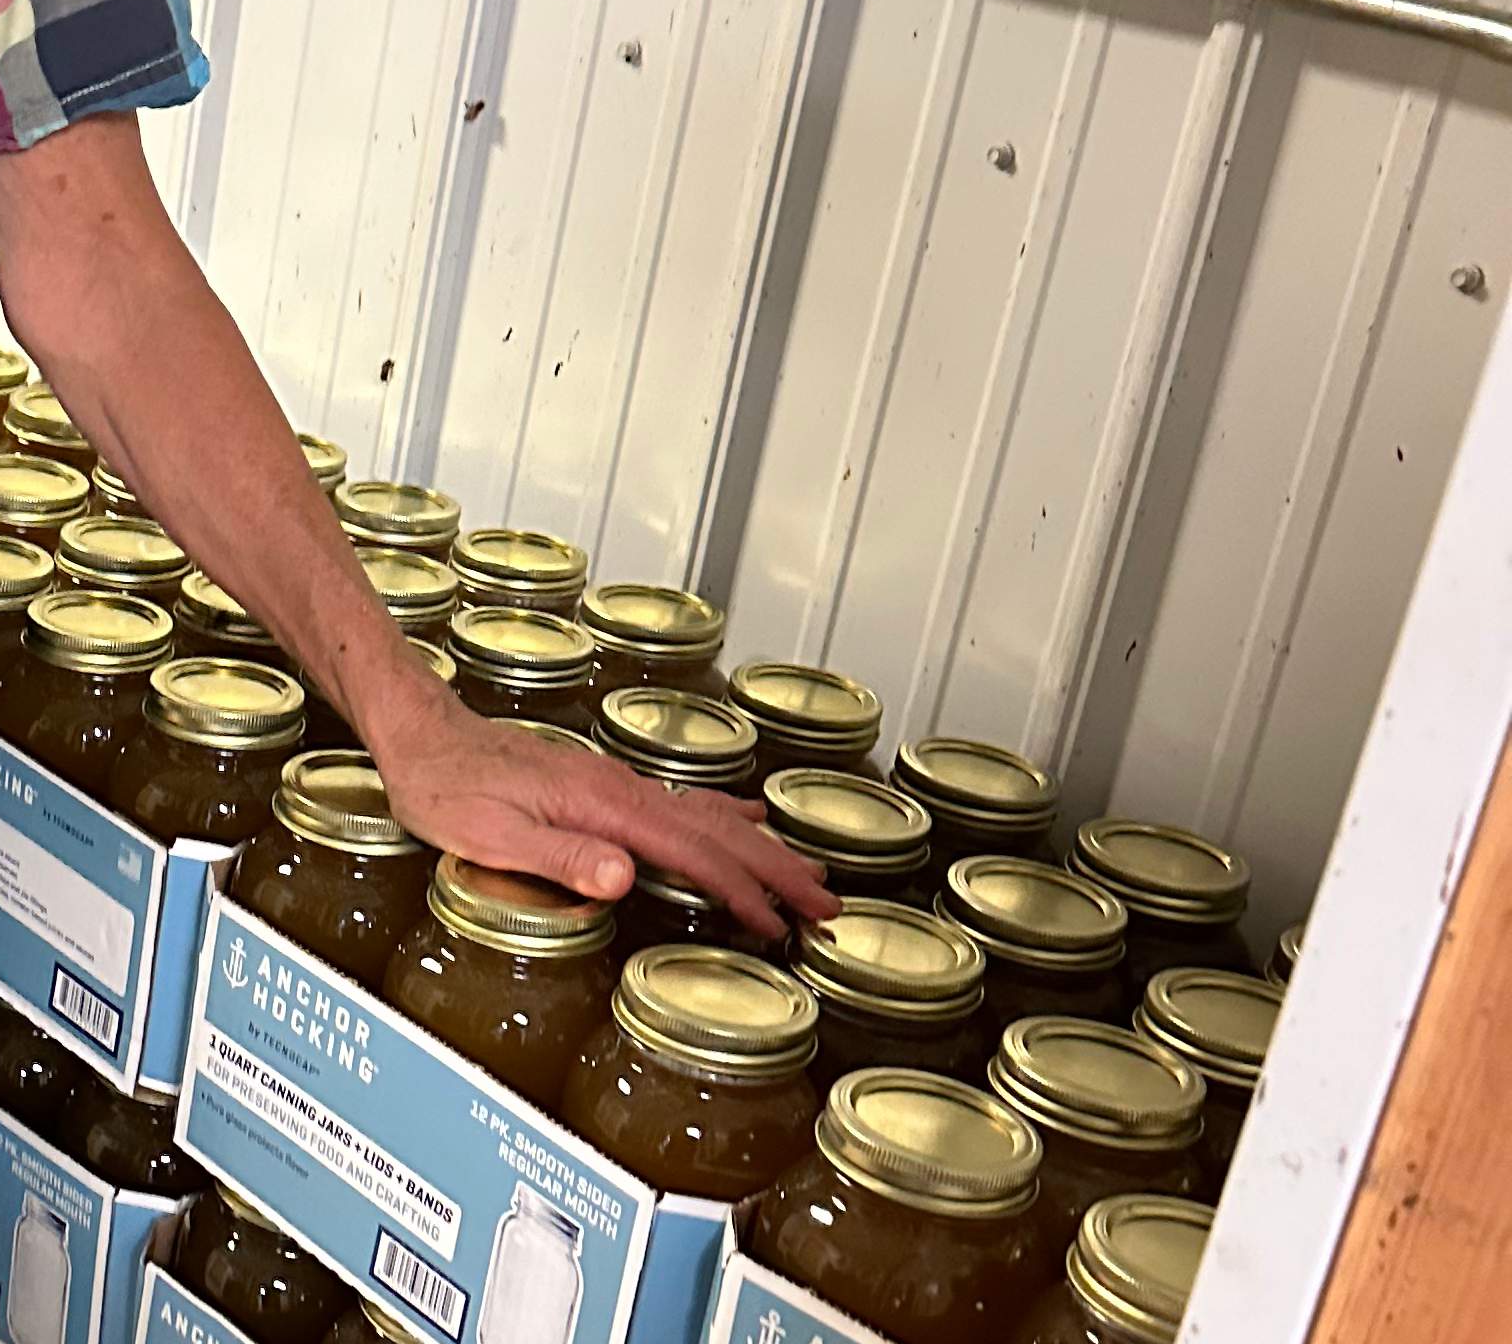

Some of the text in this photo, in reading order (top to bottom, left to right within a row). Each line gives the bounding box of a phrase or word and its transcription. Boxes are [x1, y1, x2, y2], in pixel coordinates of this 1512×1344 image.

[248, 1021, 262, 1040] by
[252, 981, 373, 1085] HOCKING
[257, 954, 371, 1048] ANCHOR
[206, 1057, 440, 1243] FOR PRESERVING FOOD AND CRAFTING
[209, 1034, 217, 1049] 1
[218, 1040, 260, 1079] QUART
[261, 1070, 317, 1121] CANNING
[317, 1111, 353, 1147] JARS
[363, 1147, 395, 1179] LIDS
[405, 1181, 454, 1224] BANDS
[470, 1100, 622, 1220] 12 PK. SMOOTH SIDED
[499, 1142, 618, 1241] REGULAR MOUTH
